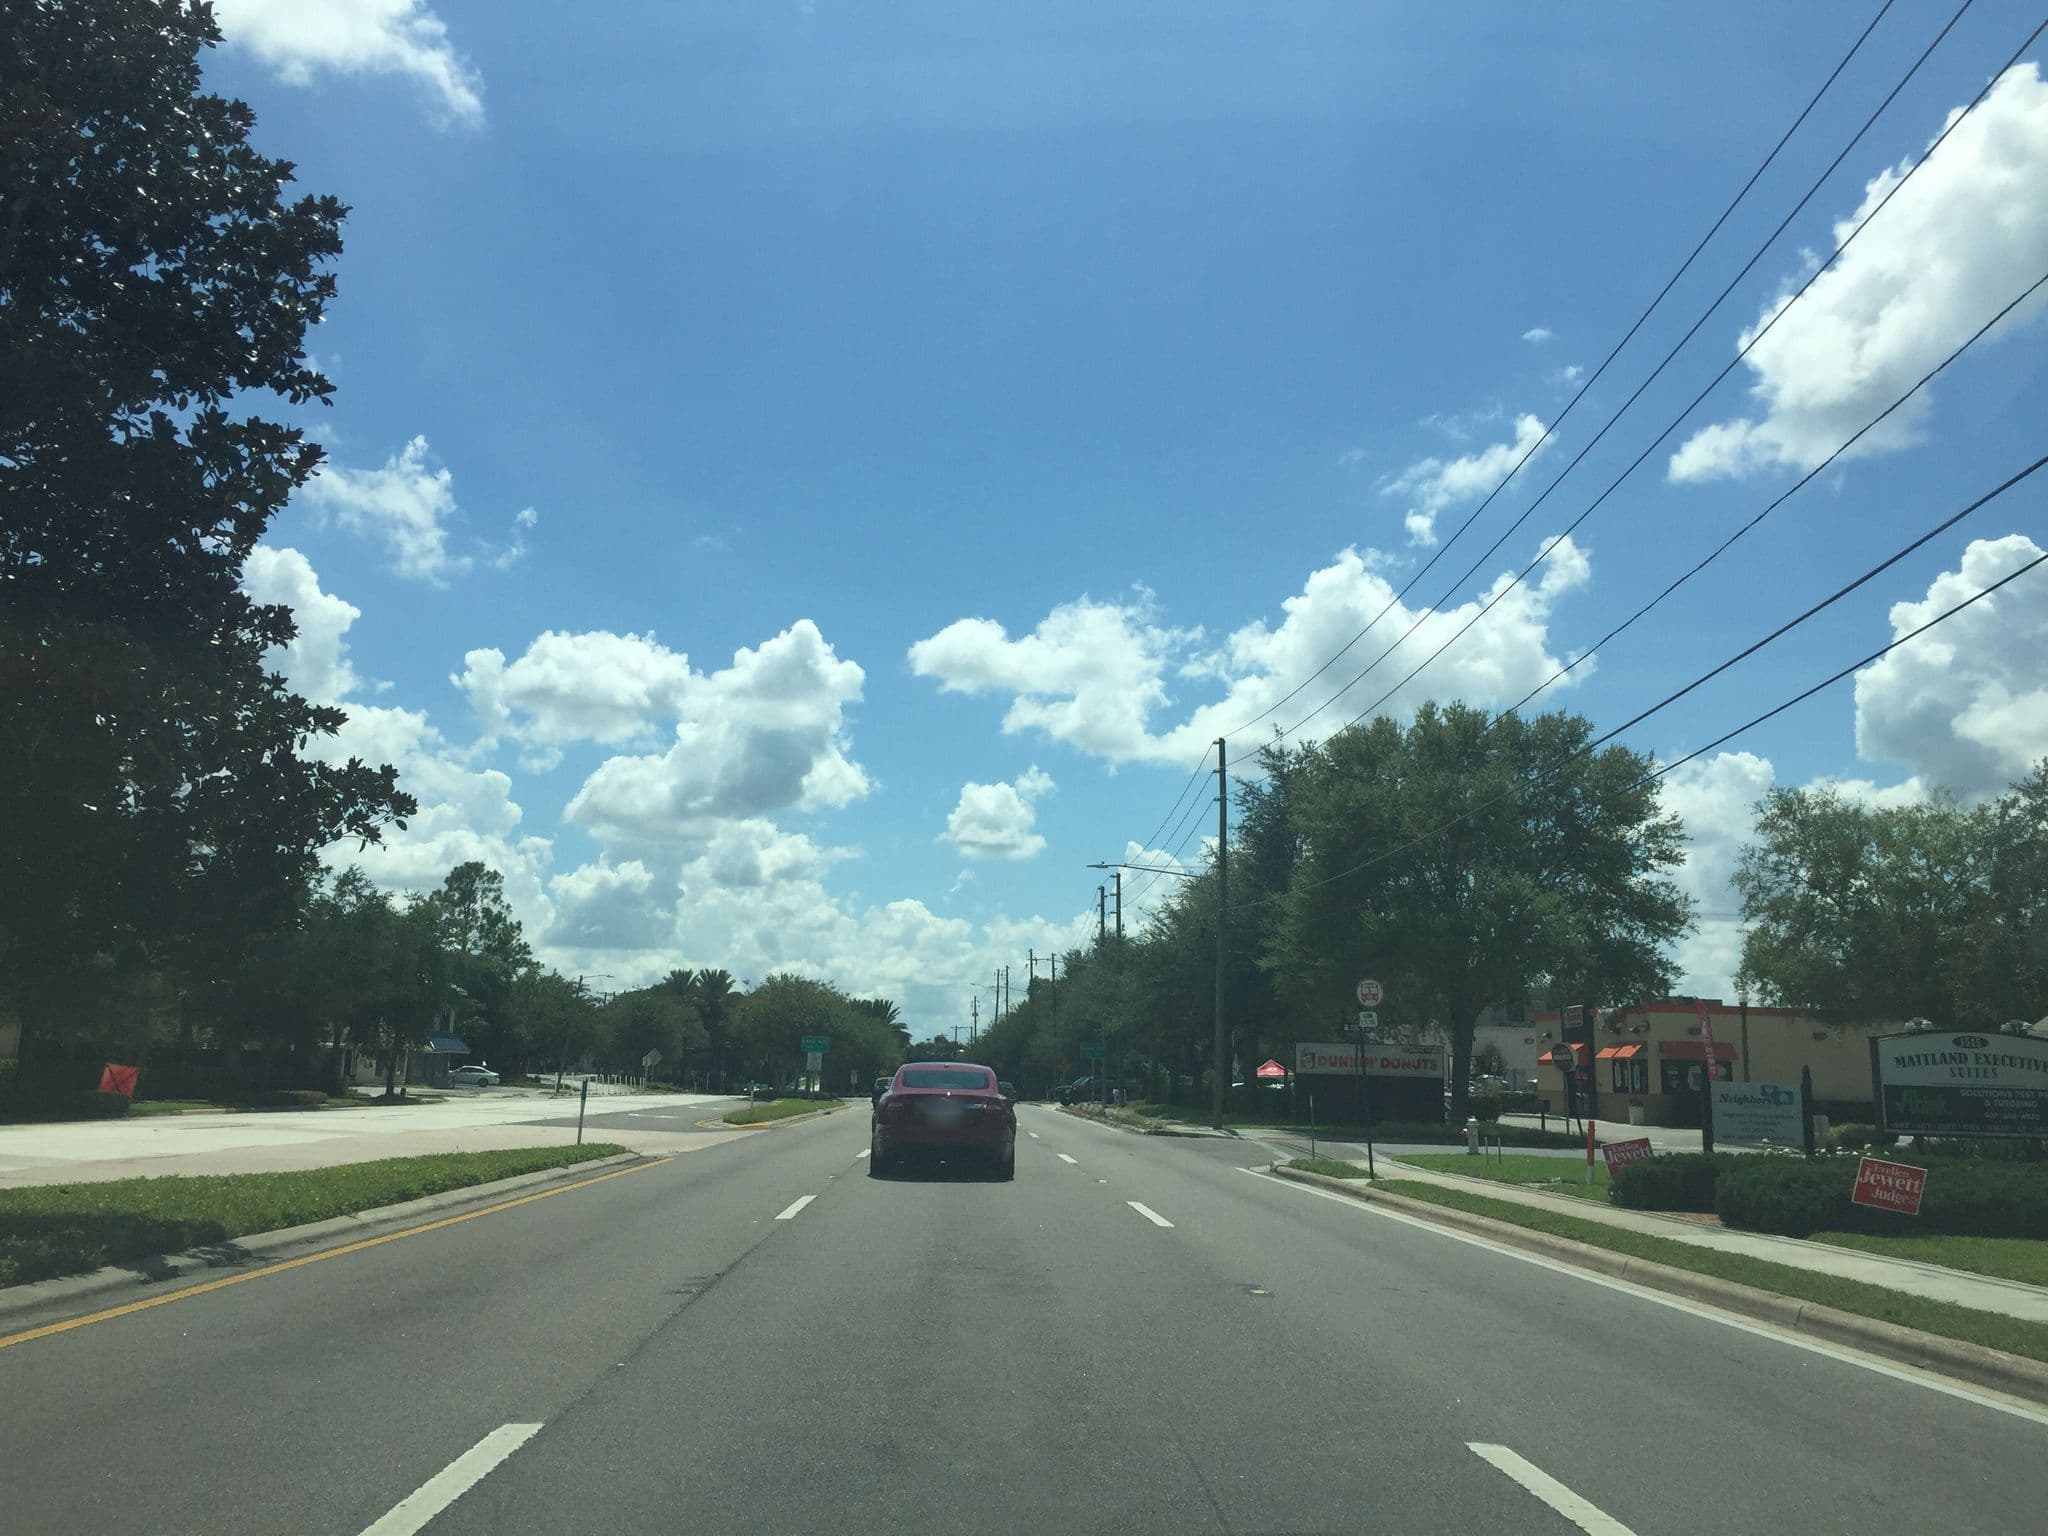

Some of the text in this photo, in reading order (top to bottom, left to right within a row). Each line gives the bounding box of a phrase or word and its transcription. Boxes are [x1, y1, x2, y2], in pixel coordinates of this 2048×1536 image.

[1380, 1057, 1438, 1071] DONUTS
[1894, 1052, 2048, 1072] MAITLAND EXECUTIVE
[1950, 1067, 1998, 1079] SUITES
[1719, 1093, 1773, 1105] Neighbors
[1960, 1088, 2012, 1098] SOLUTIONS
[1859, 1166, 1921, 1194] Jewett
[1871, 1185, 1909, 1205] Judge
